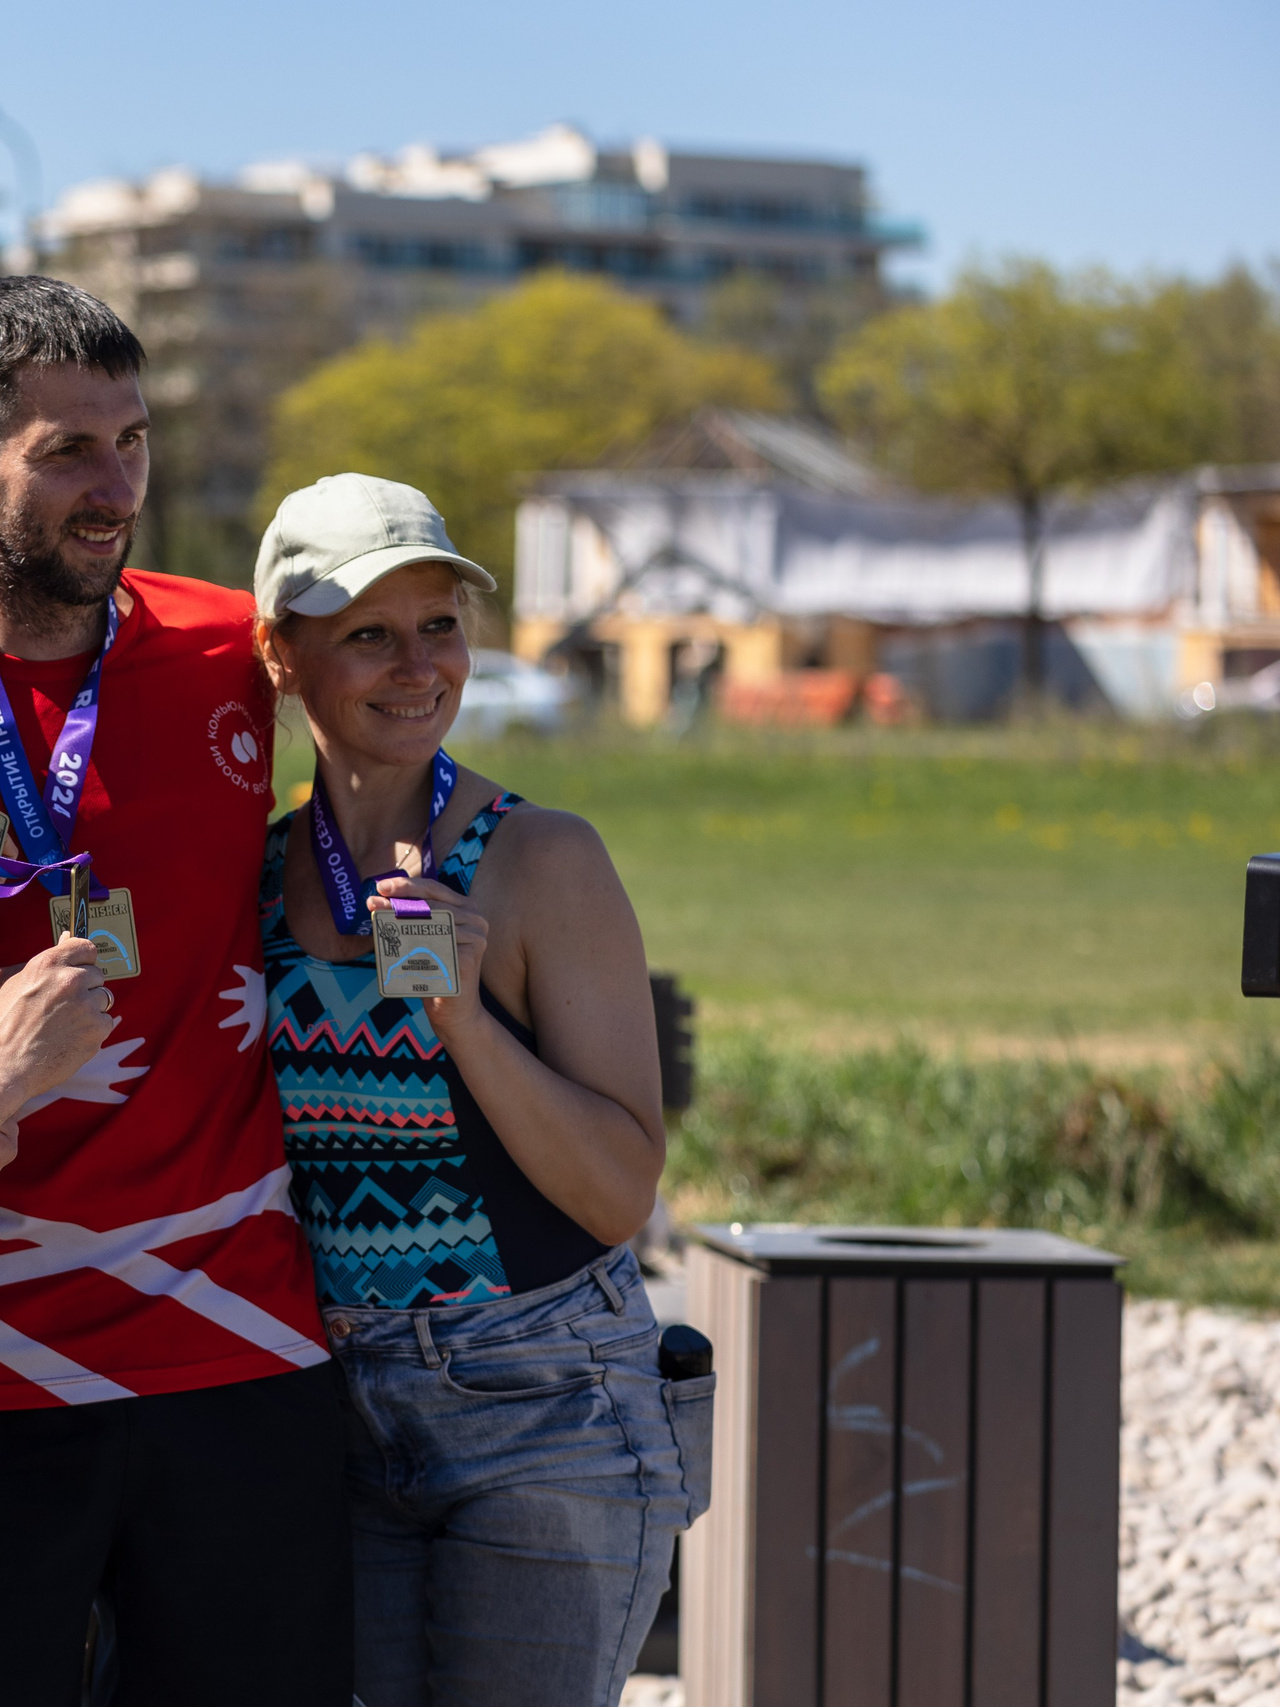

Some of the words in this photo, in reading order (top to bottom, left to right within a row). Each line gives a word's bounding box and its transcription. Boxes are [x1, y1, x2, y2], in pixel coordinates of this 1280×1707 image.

[0, 750, 45, 839] ОТКРЫТИЕ
[209, 745, 250, 792] КРОВИ
[327, 852, 357, 920] ГРЕБНОГО
[401, 924, 452, 936] FINISHER
